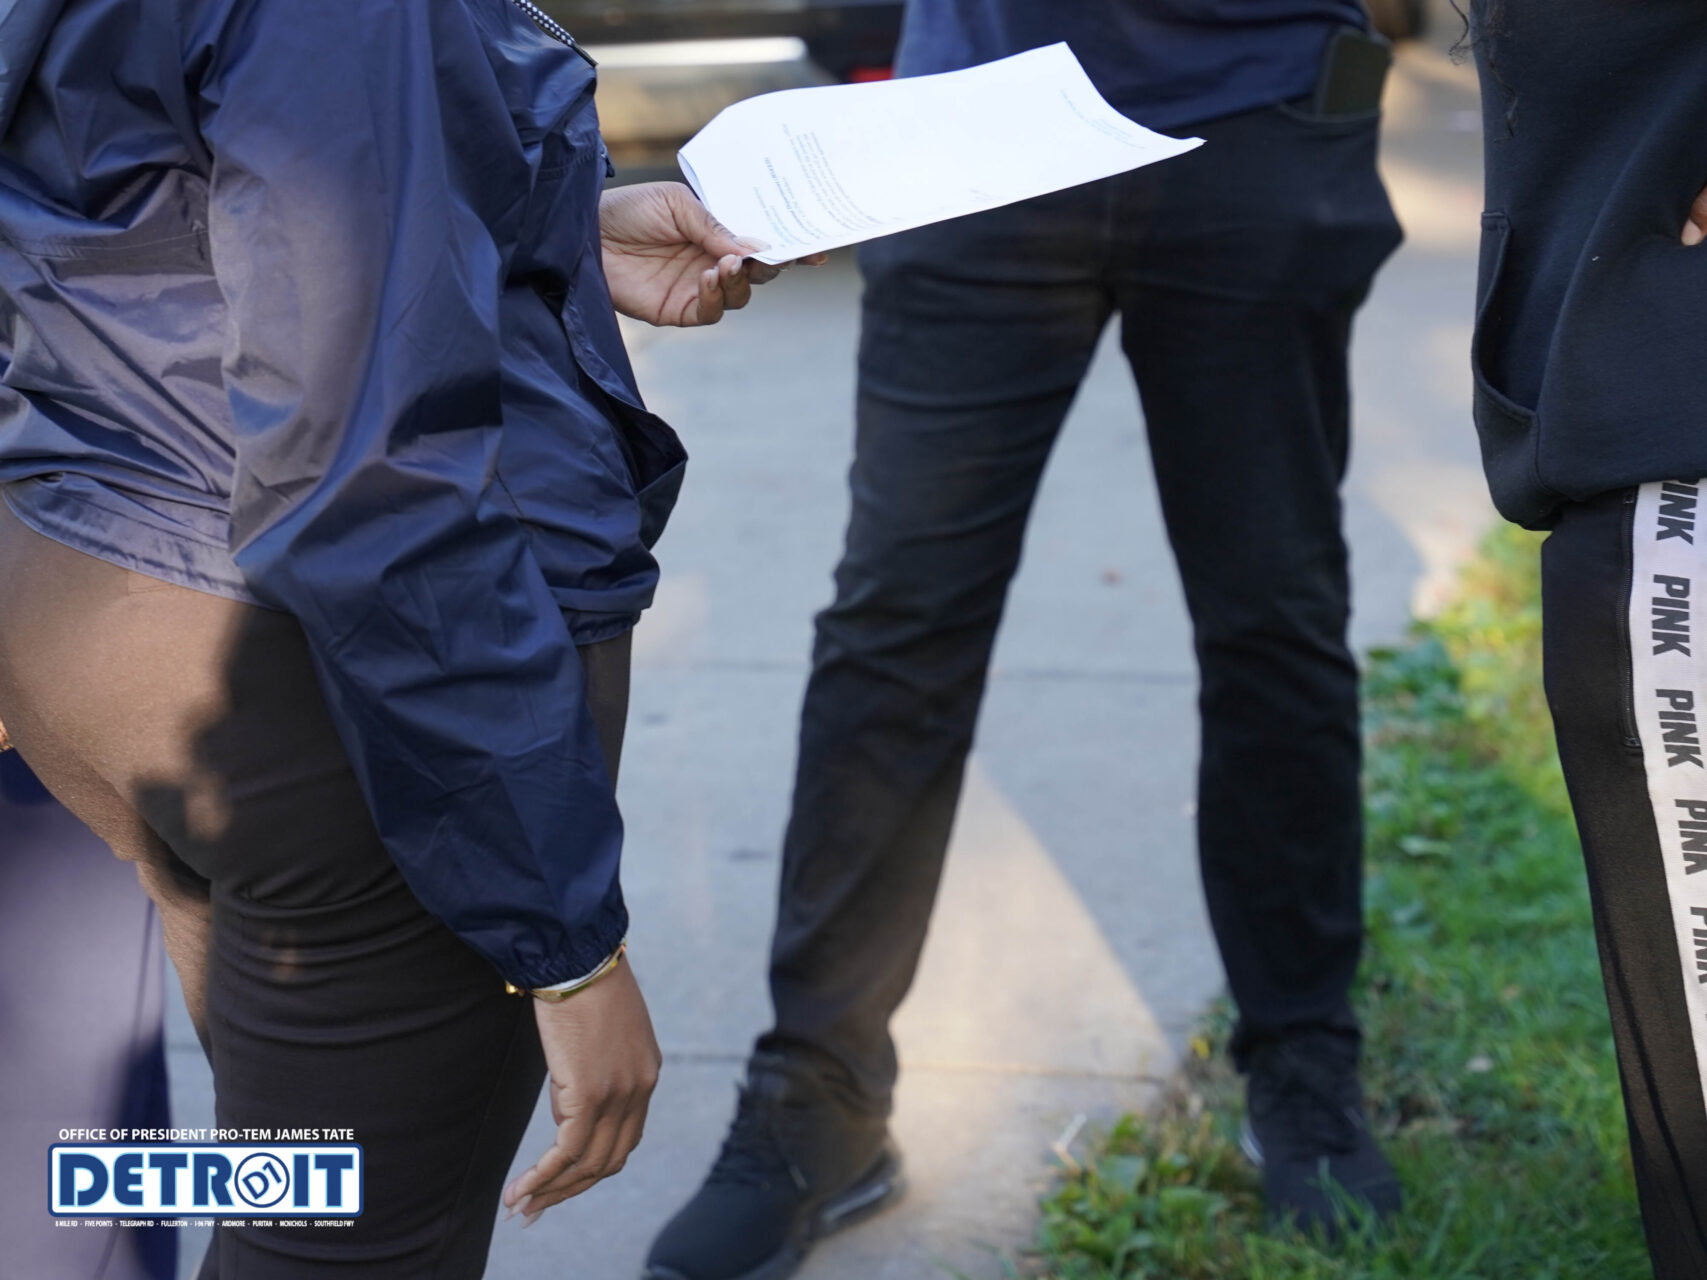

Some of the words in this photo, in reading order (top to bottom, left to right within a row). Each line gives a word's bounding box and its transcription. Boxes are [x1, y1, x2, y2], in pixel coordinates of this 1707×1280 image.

[1656, 480, 1699, 545] INK
[1652, 574, 1692, 657] PINK
[1655, 688, 1704, 768] PINK
